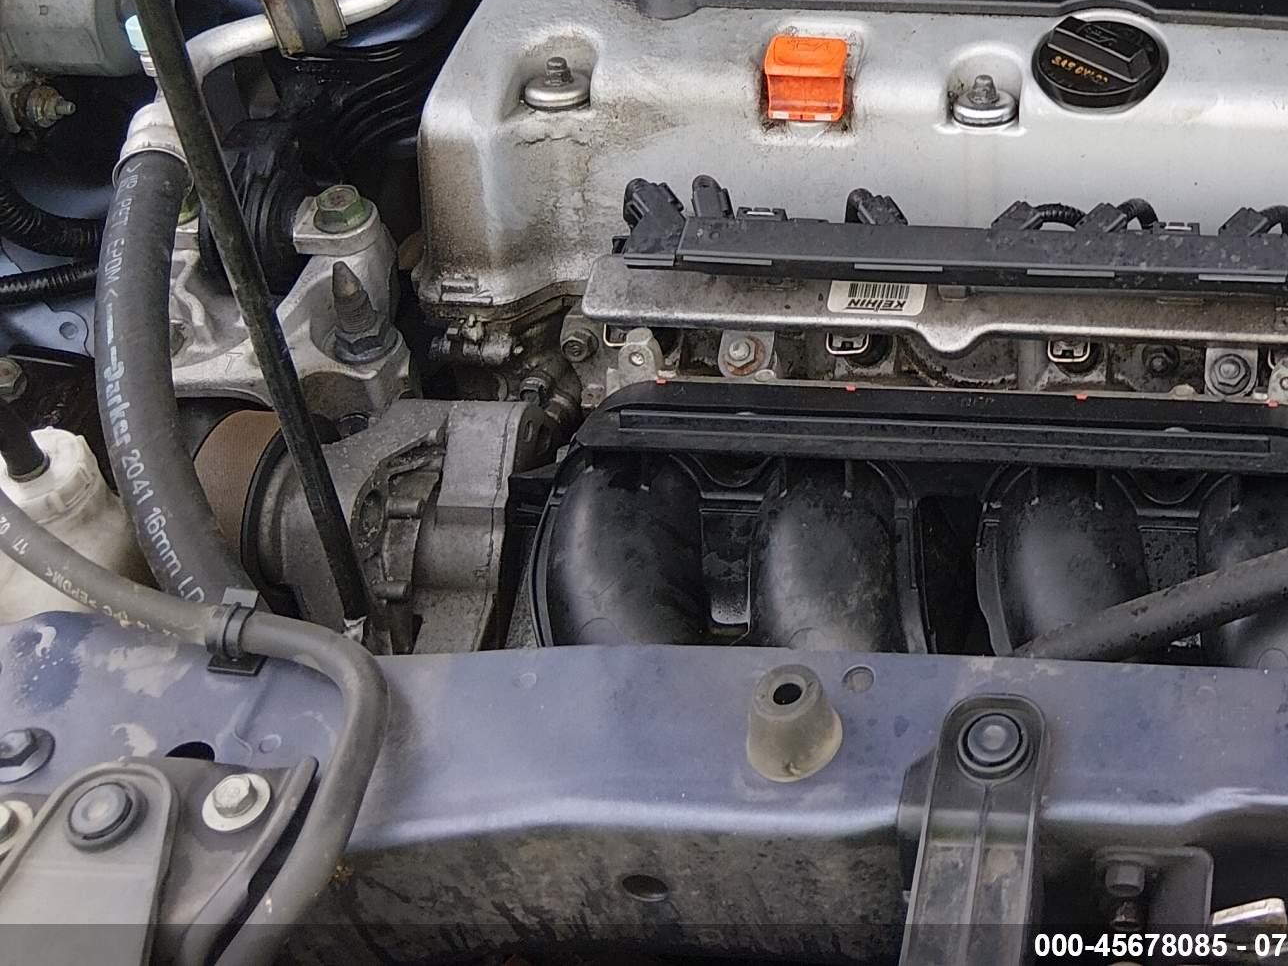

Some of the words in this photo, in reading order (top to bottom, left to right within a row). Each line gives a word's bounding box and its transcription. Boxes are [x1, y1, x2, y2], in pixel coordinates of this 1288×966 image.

[847, 298, 906, 312] KEIHIN
[121, 449, 154, 506] 2041
[144, 507, 182, 578] 16mm
[12, 538, 29, 555] 17
